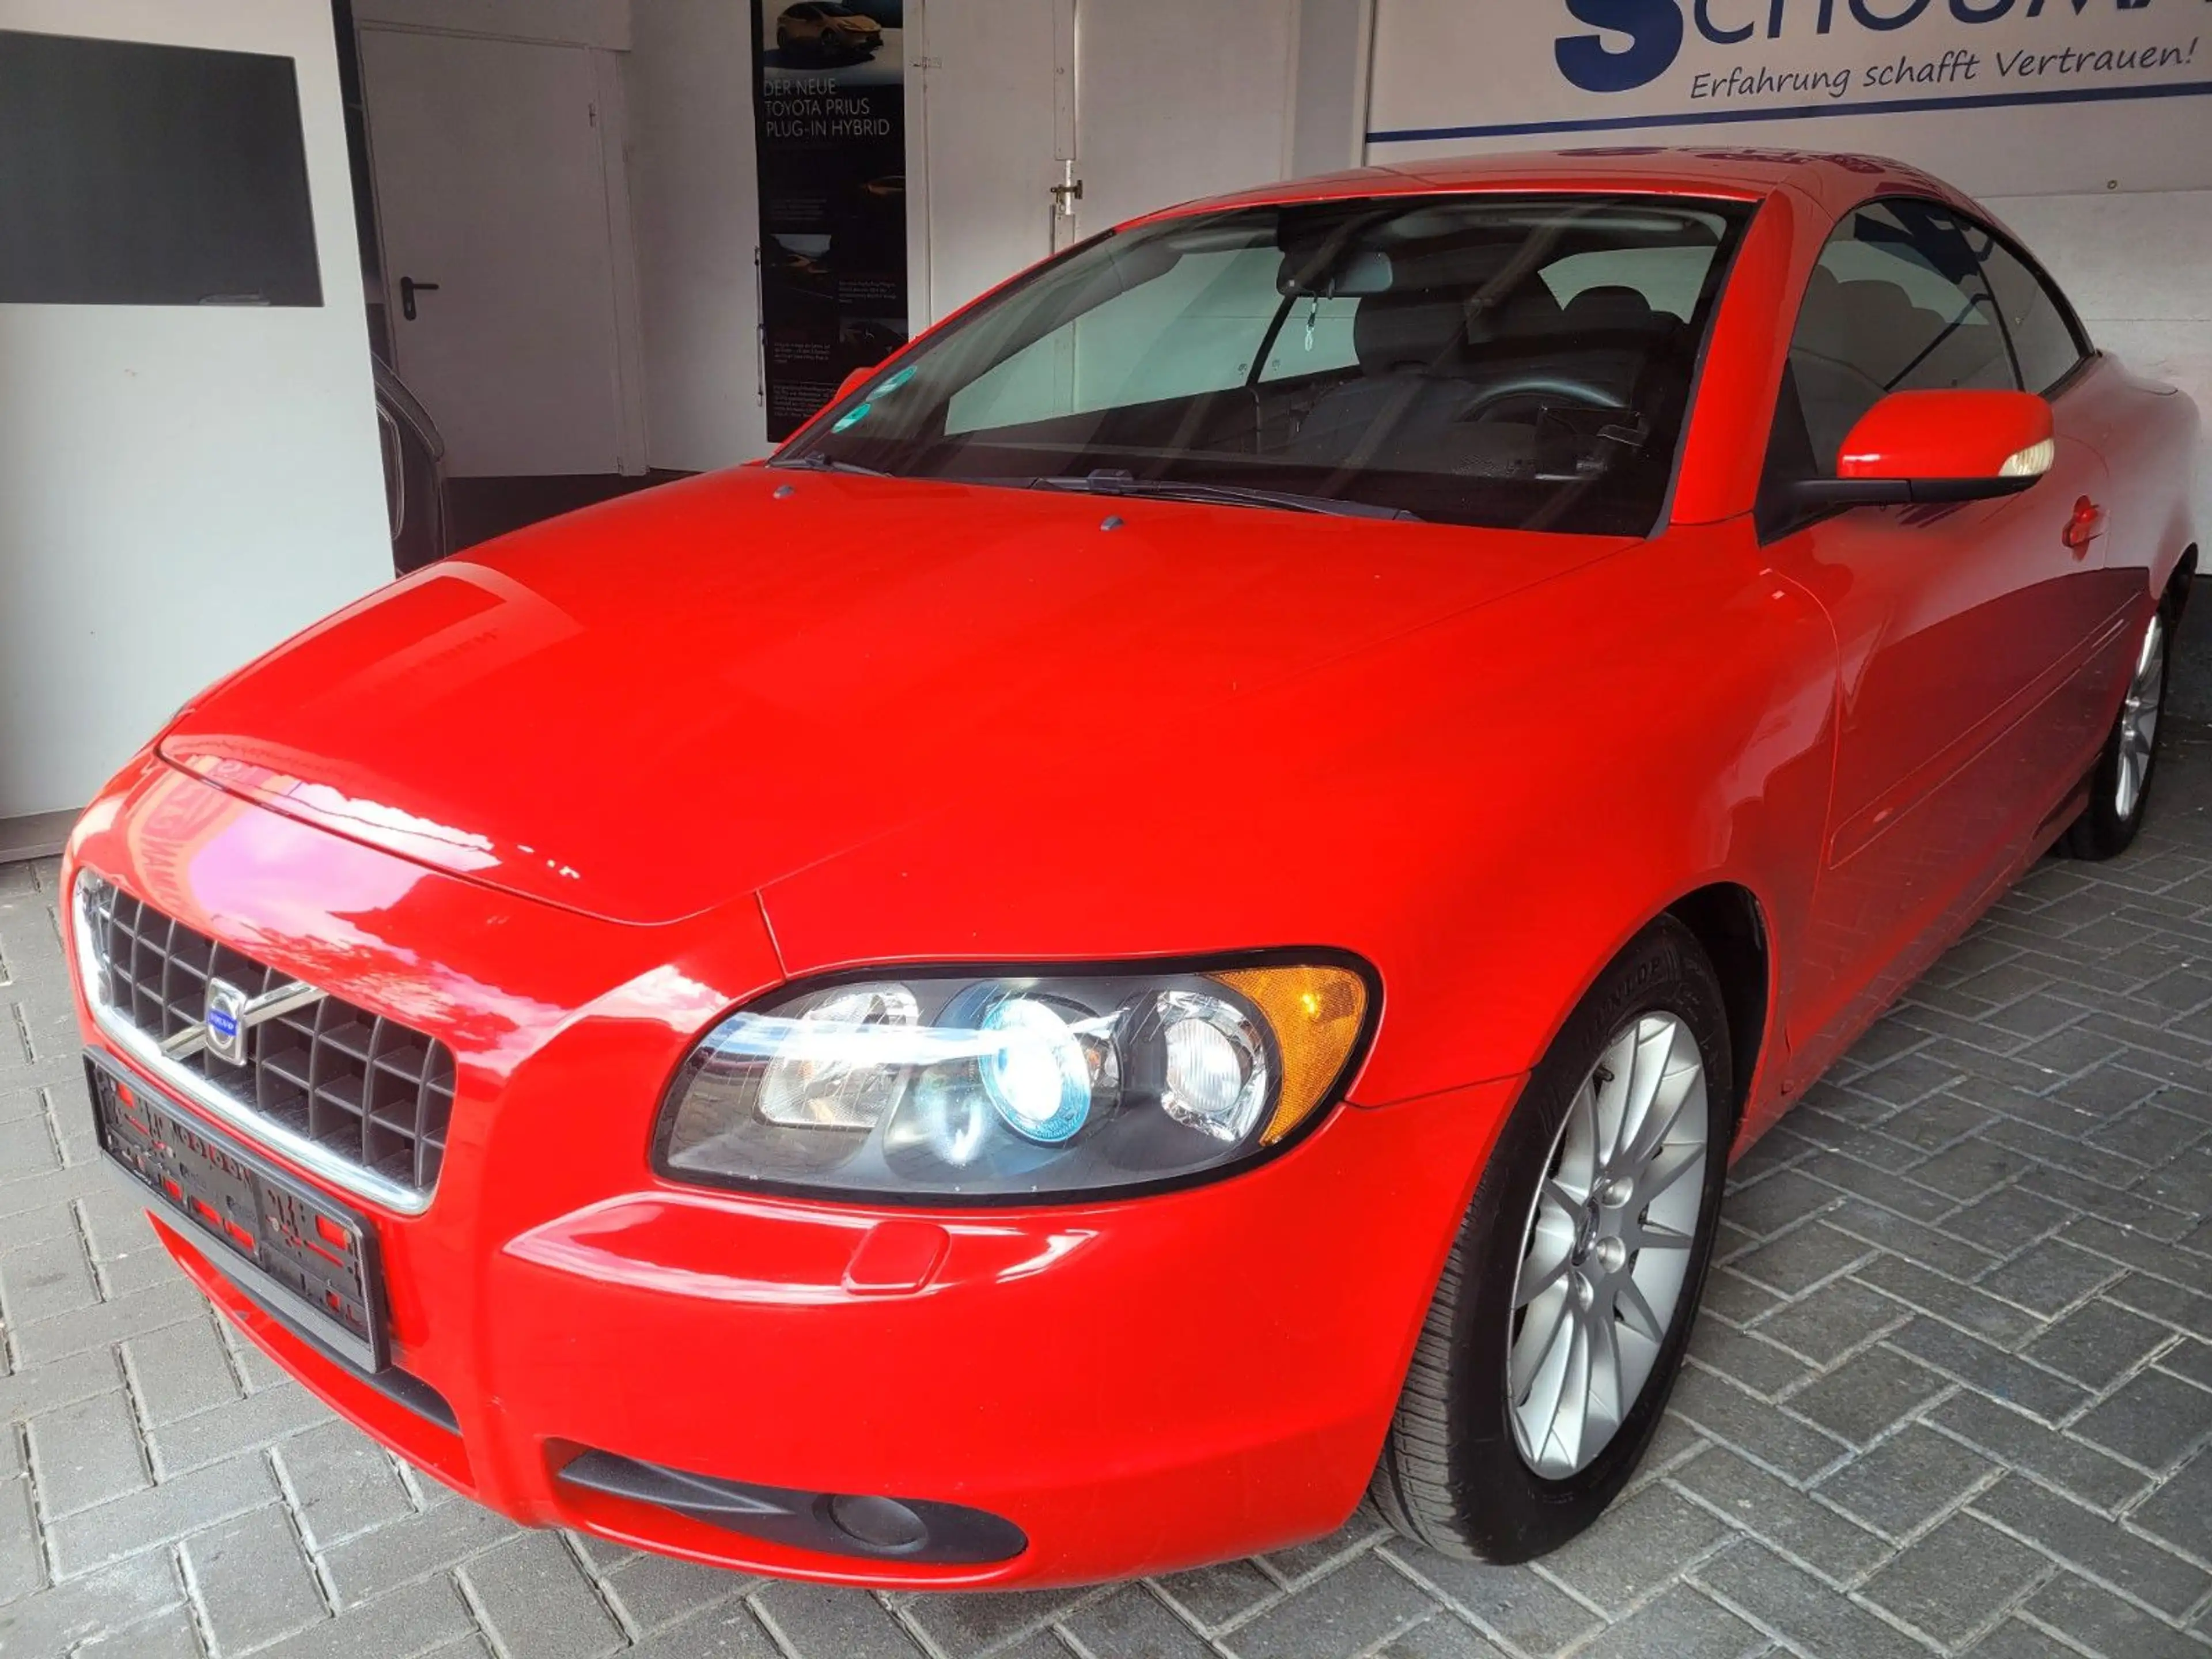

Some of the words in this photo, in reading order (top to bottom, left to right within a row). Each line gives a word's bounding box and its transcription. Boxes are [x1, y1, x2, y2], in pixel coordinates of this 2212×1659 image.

[1690, 66, 1850, 99] Erfahrung
[1863, 50, 1980, 86] schafft
[1996, 37, 2199, 78] Vertrauen!
[763, 79, 792, 97] DER
[796, 77, 837, 95] NEUE
[764, 99, 822, 116] TOYOTA
[825, 97, 870, 116] PRIUS
[766, 120, 827, 138] PLUG-IN
[832, 118, 890, 137] HYBRID
